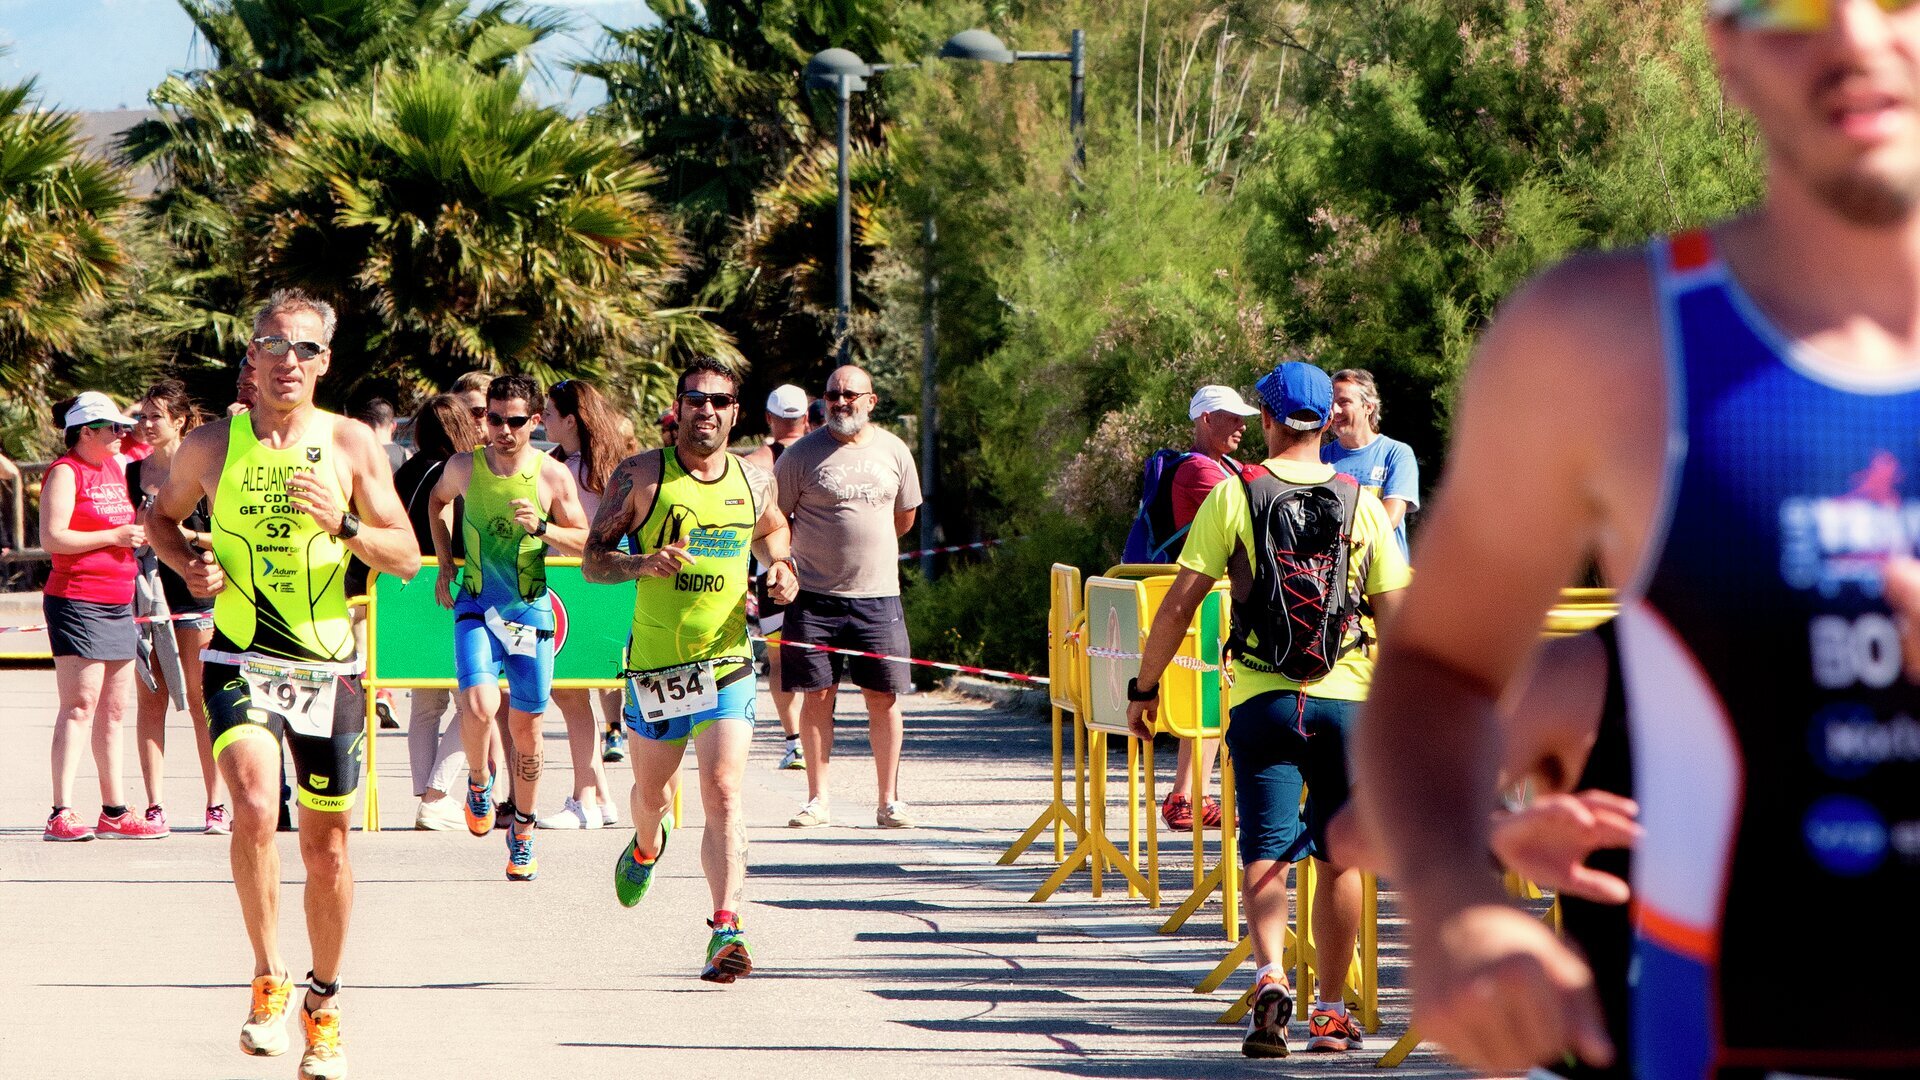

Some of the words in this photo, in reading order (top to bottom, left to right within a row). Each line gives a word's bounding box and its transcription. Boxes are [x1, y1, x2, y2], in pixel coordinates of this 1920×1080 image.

[241, 467, 312, 492] ALEJAND
[264, 494, 289, 503] CDT
[240, 505, 266, 515] GET
[271, 505, 306, 515] GOIN
[267, 523, 290, 538] S2
[689, 529, 737, 539] CLUB
[675, 573, 724, 592] ISIDRO
[650, 672, 704, 704] 154
[311, 797, 345, 807] GOING
